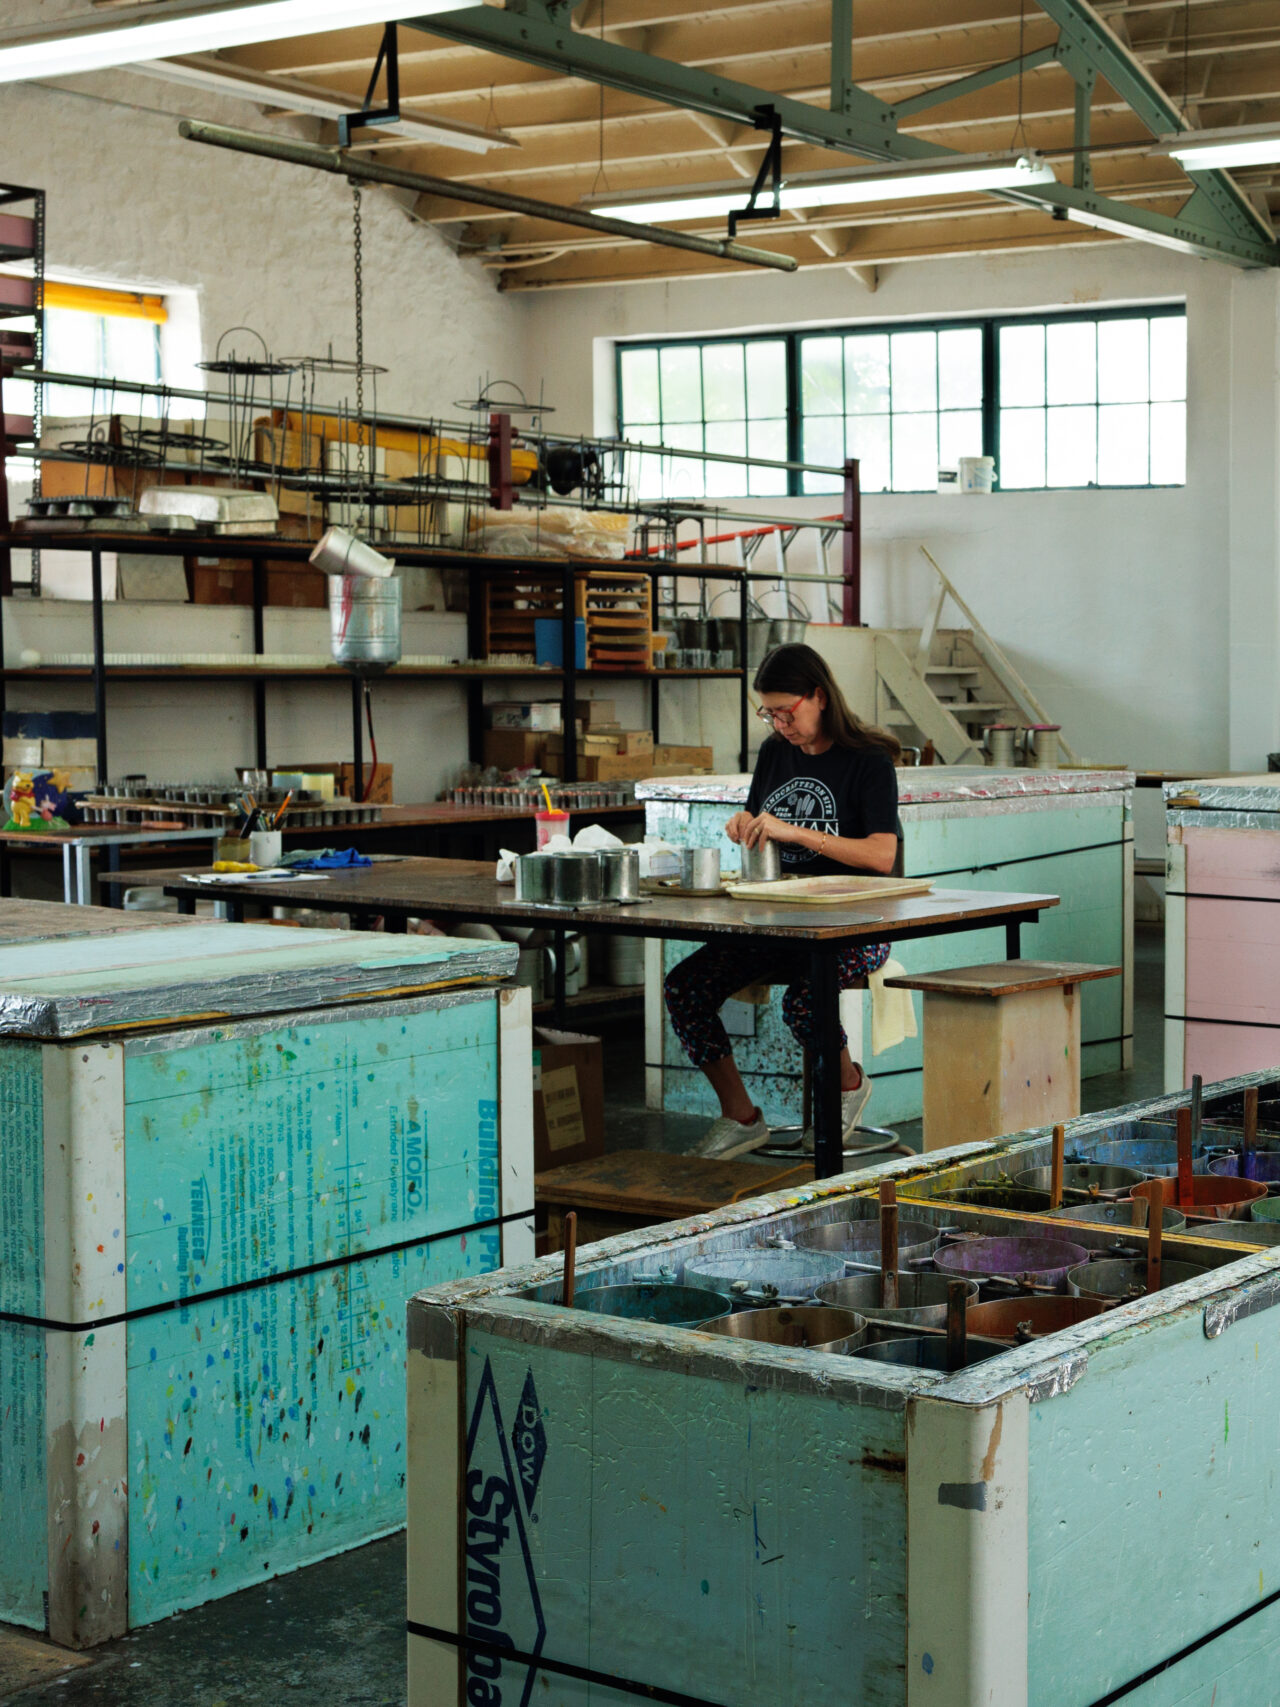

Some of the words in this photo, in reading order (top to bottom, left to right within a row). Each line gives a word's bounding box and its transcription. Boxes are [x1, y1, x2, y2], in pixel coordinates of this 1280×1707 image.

[763, 781, 815, 813] ANDCRAFTED
[822, 795, 833, 815] SITE
[475, 1099, 499, 1223] Building
[176, 1225, 189, 1273] Building
[191, 1176, 205, 1262] TENNECO
[521, 1405, 537, 1485] DOW
